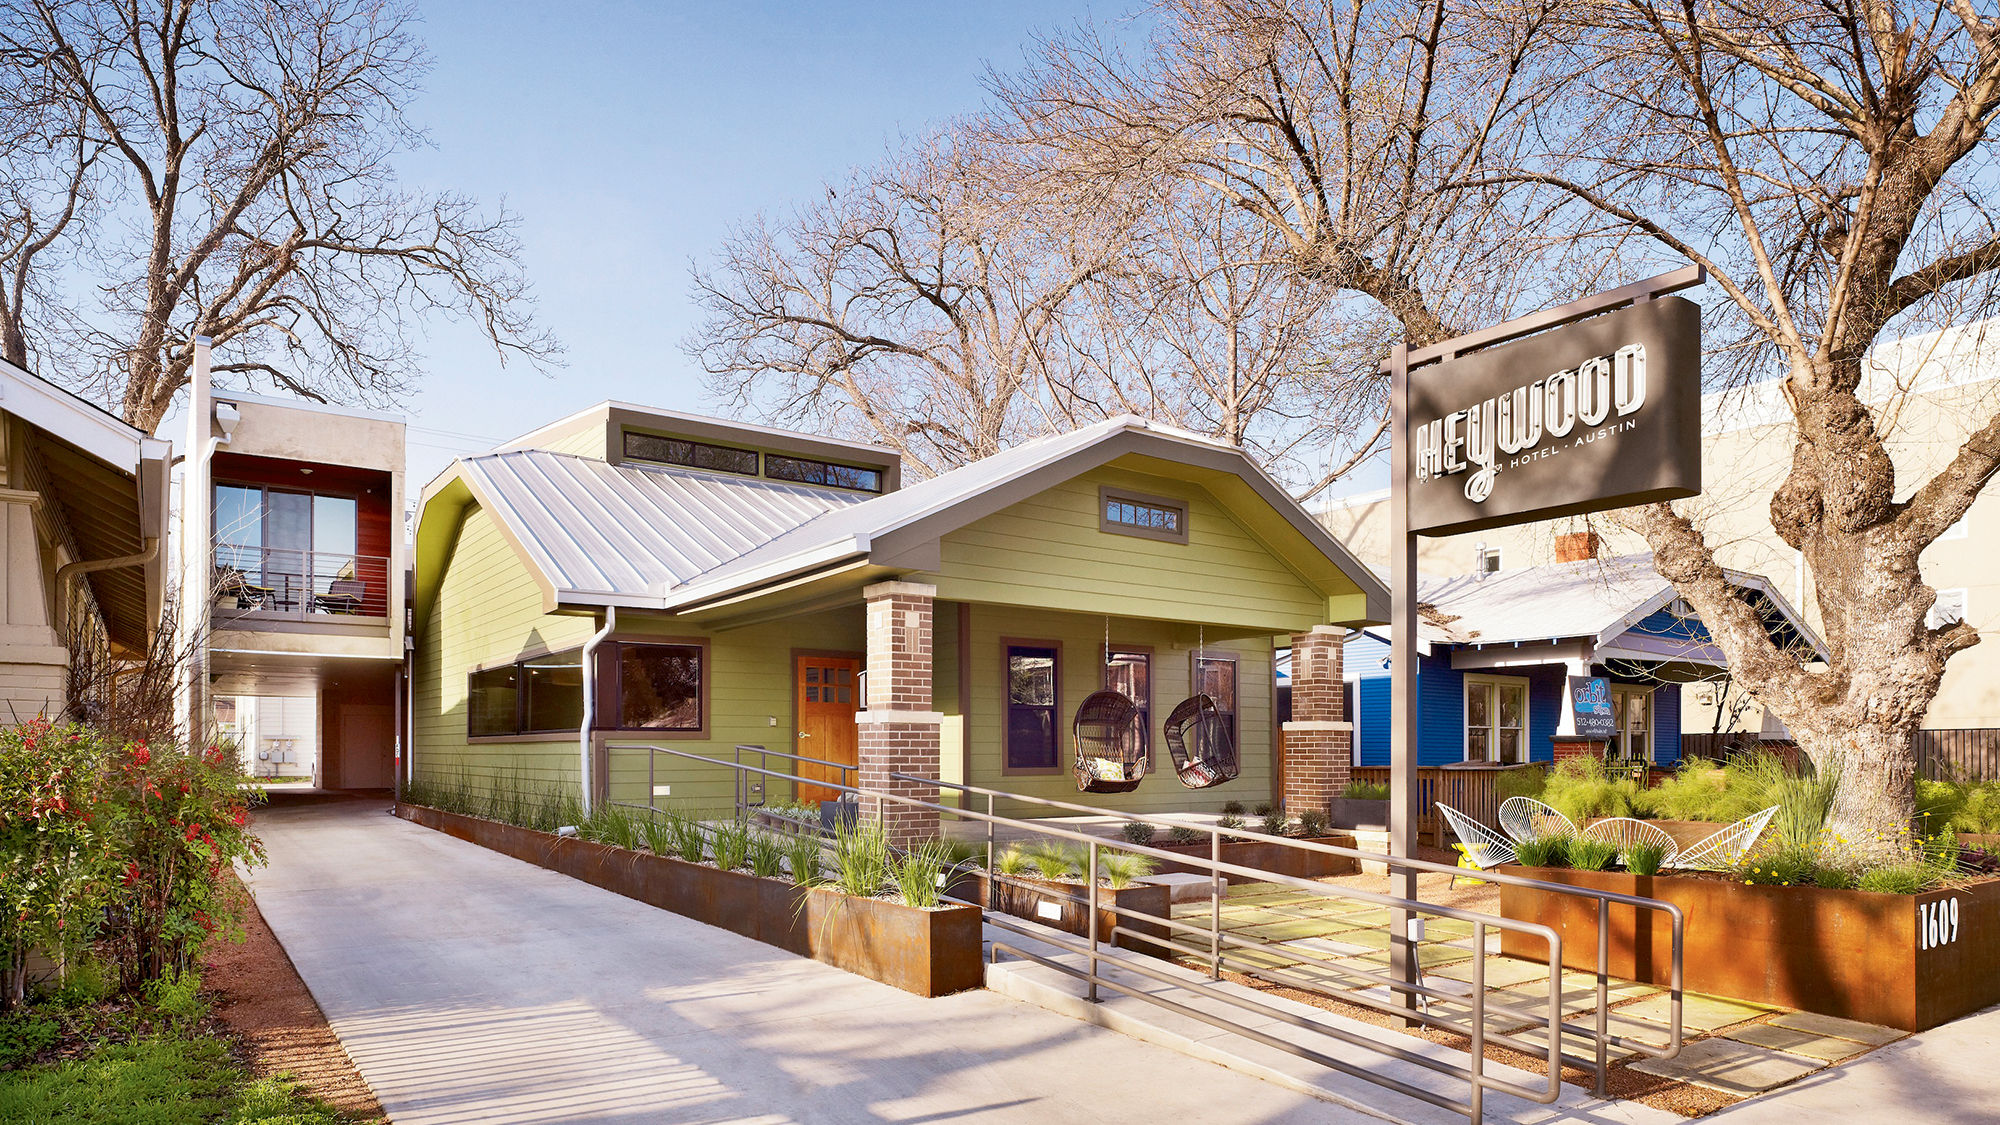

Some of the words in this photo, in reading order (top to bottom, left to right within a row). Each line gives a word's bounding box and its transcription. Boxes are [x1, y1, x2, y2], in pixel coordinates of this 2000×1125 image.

[1416, 343, 1646, 503] HEYWOOD
[1510, 448, 1560, 469] HOTEL
[1574, 418, 1636, 448] AUSTIN
[1574, 681, 1607, 704] orbit
[1920, 897, 1959, 951] 1609
